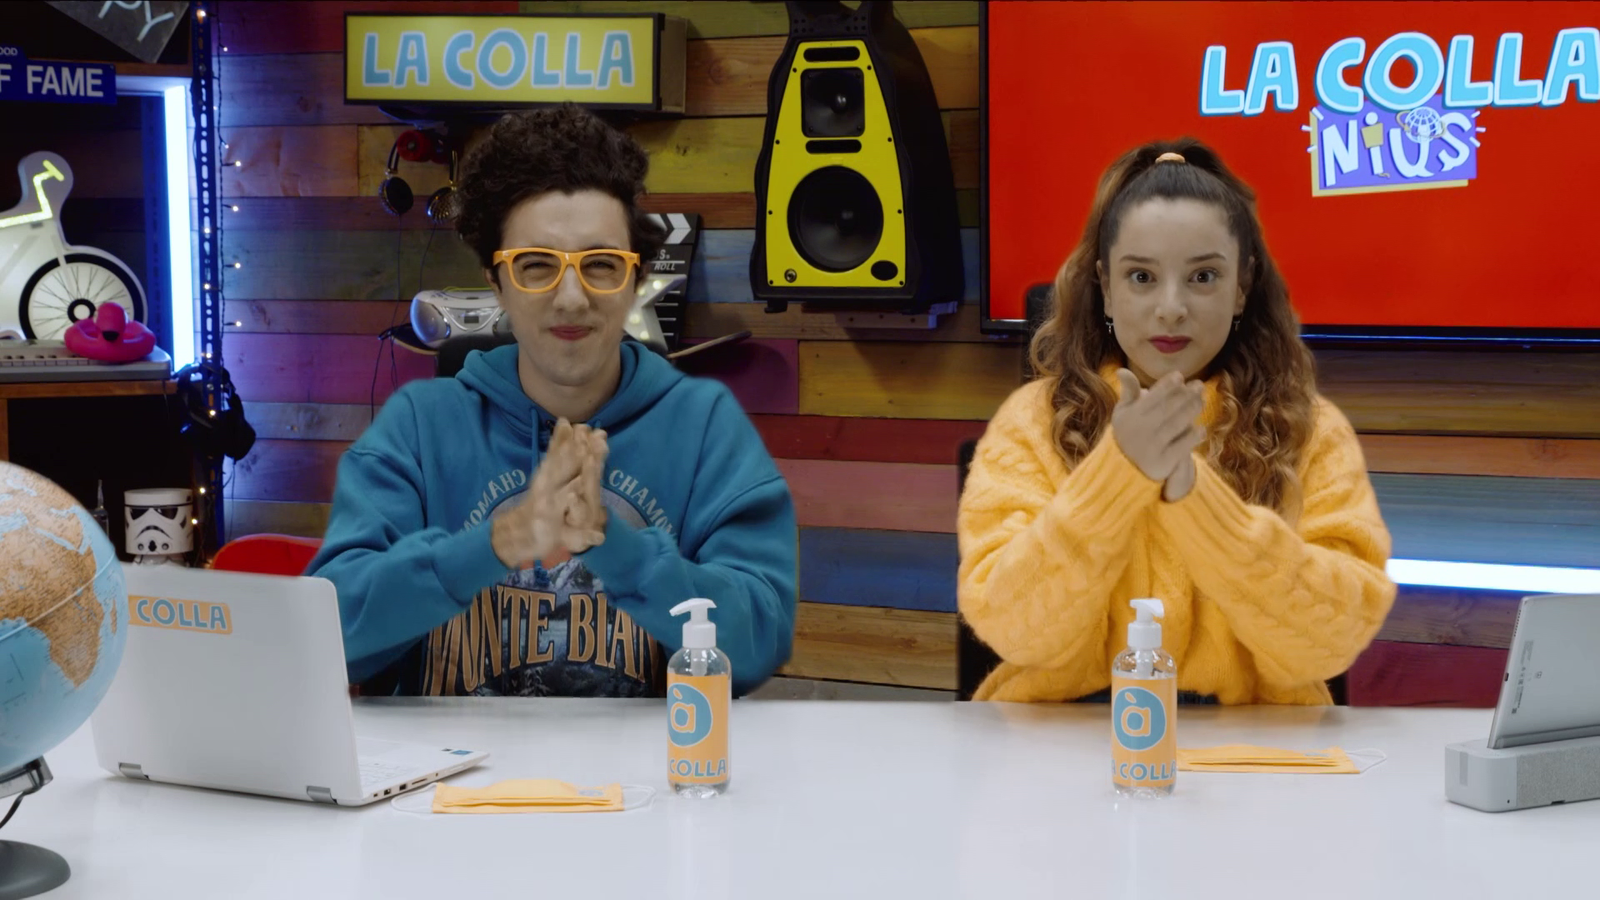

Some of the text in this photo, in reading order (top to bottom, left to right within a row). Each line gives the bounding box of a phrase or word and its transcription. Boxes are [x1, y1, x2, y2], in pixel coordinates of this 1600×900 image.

[363, 28, 635, 90] LA COLLA
[1200, 27, 1600, 116] LA COLLA
[26, 64, 104, 98] FAME
[136, 598, 228, 632] COLLA
[669, 758, 727, 778] COLLA
